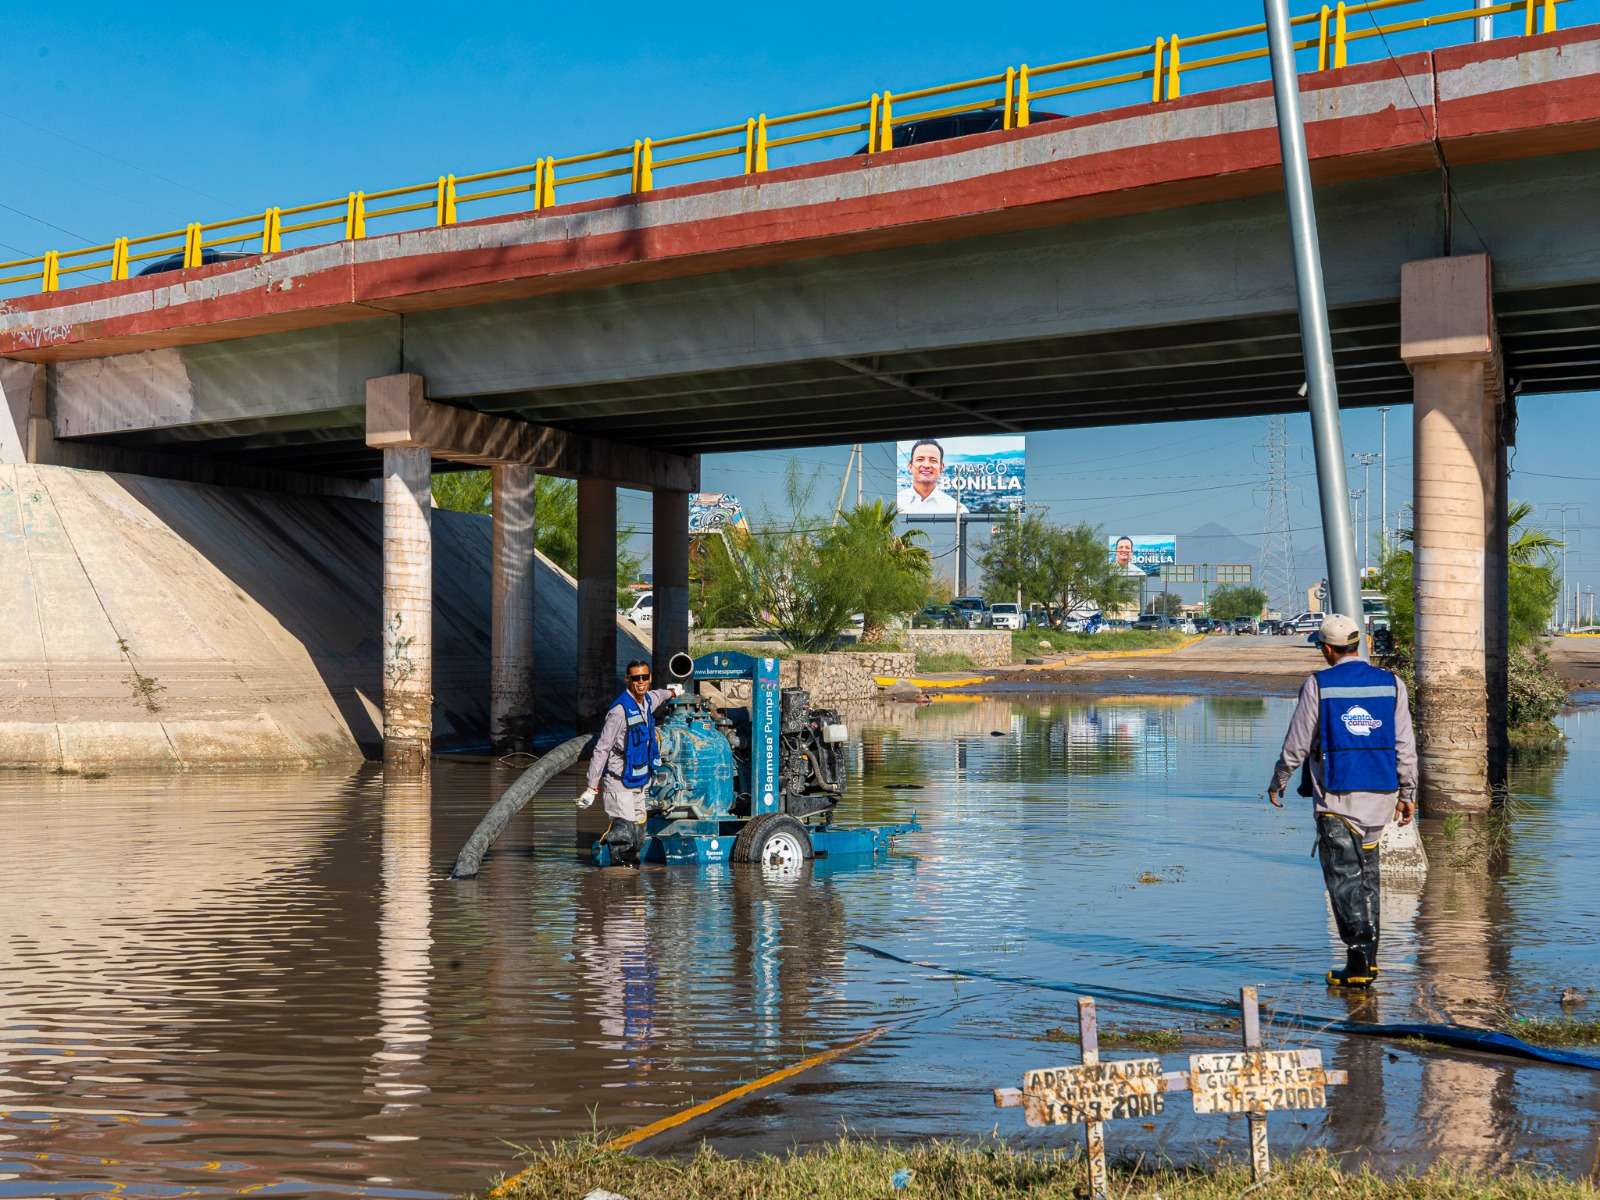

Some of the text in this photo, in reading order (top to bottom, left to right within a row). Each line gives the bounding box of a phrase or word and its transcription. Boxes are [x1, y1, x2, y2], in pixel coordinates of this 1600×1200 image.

[954, 463, 1007, 475] MARCO
[940, 475, 1022, 490] BONILLA
[1131, 555, 1174, 563] BONILLA
[764, 691, 774, 733] Pumps
[1347, 720, 1381, 729] conmigo
[764, 737, 774, 792] Barmesa
[1031, 1061, 1164, 1091] ADRIANA DIAZ
[1056, 1081, 1128, 1100] CHAVEZ
